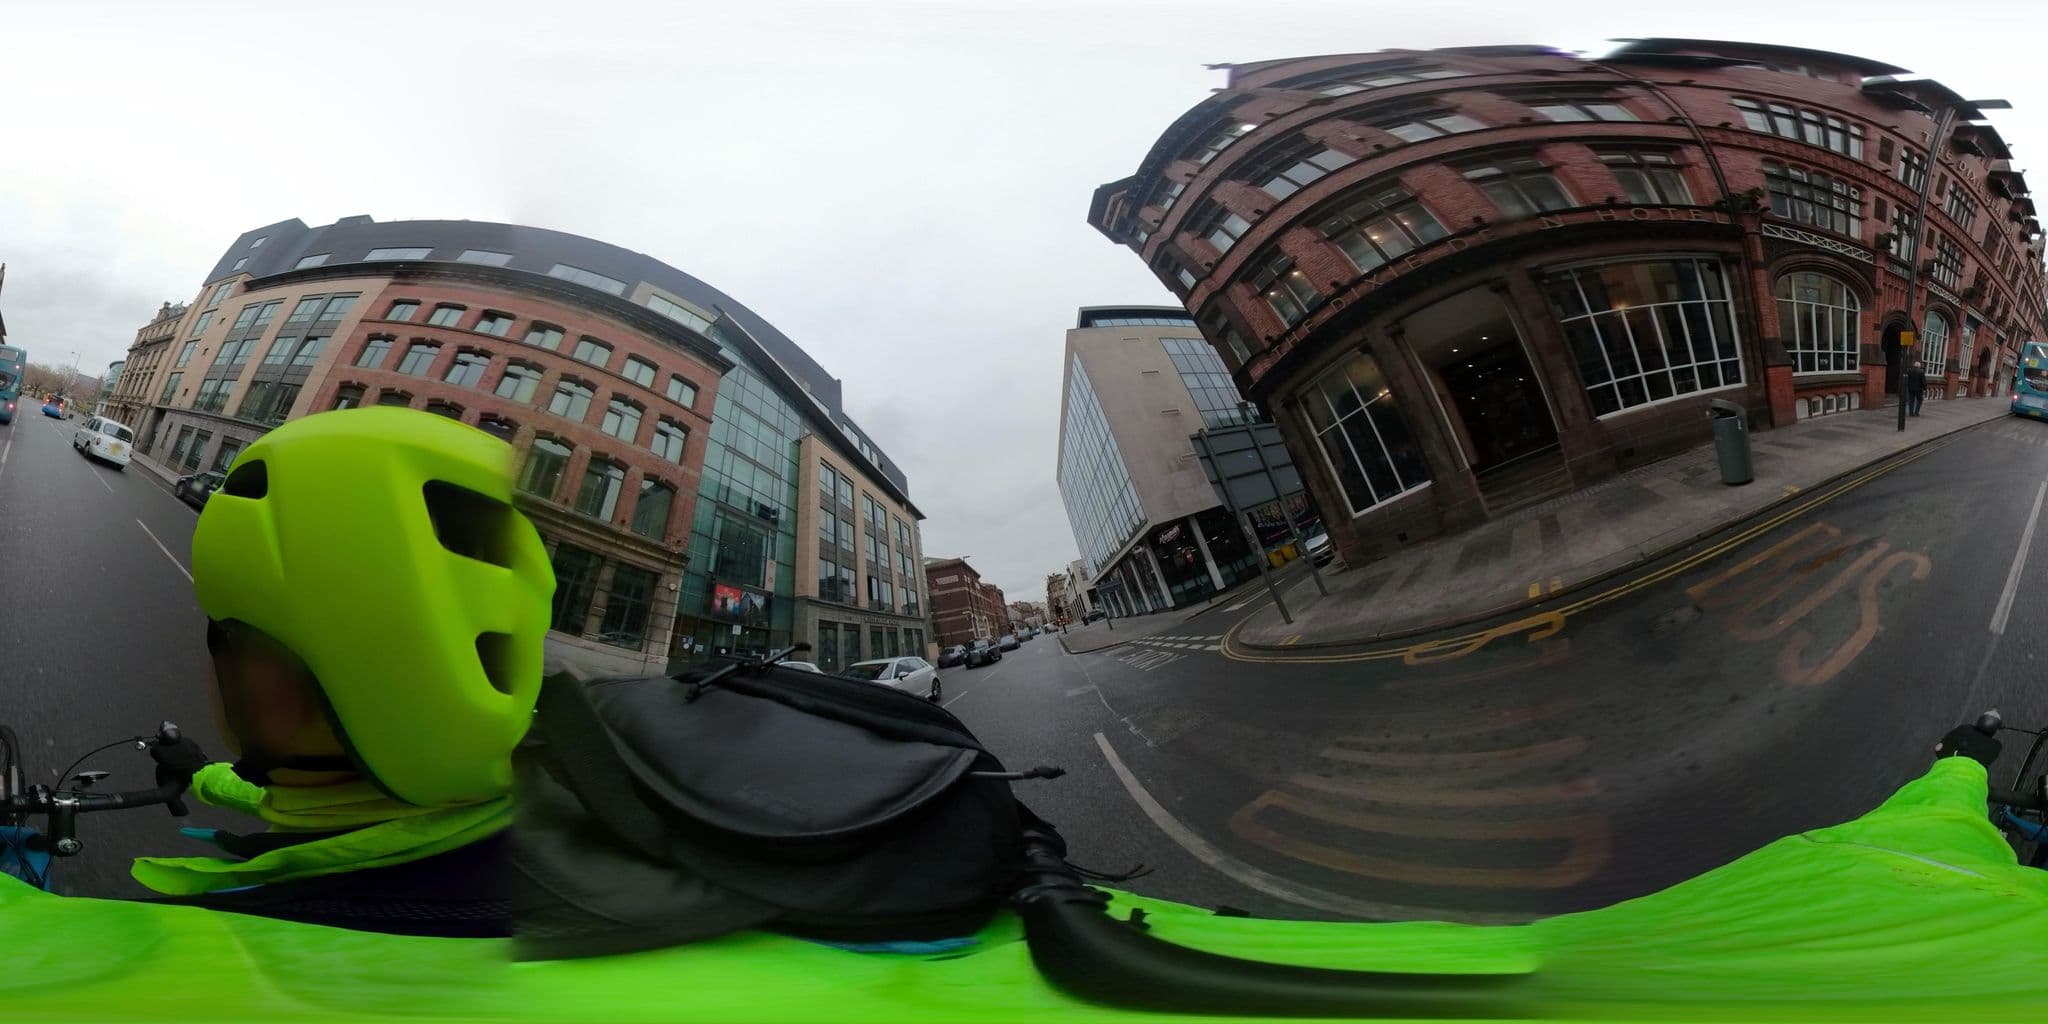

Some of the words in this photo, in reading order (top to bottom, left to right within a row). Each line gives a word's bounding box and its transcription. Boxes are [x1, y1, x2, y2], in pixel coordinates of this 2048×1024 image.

[1272, 318, 1313, 359] THE
[1330, 254, 1425, 313] DIXIE
[1597, 206, 1730, 224] HOTEL
